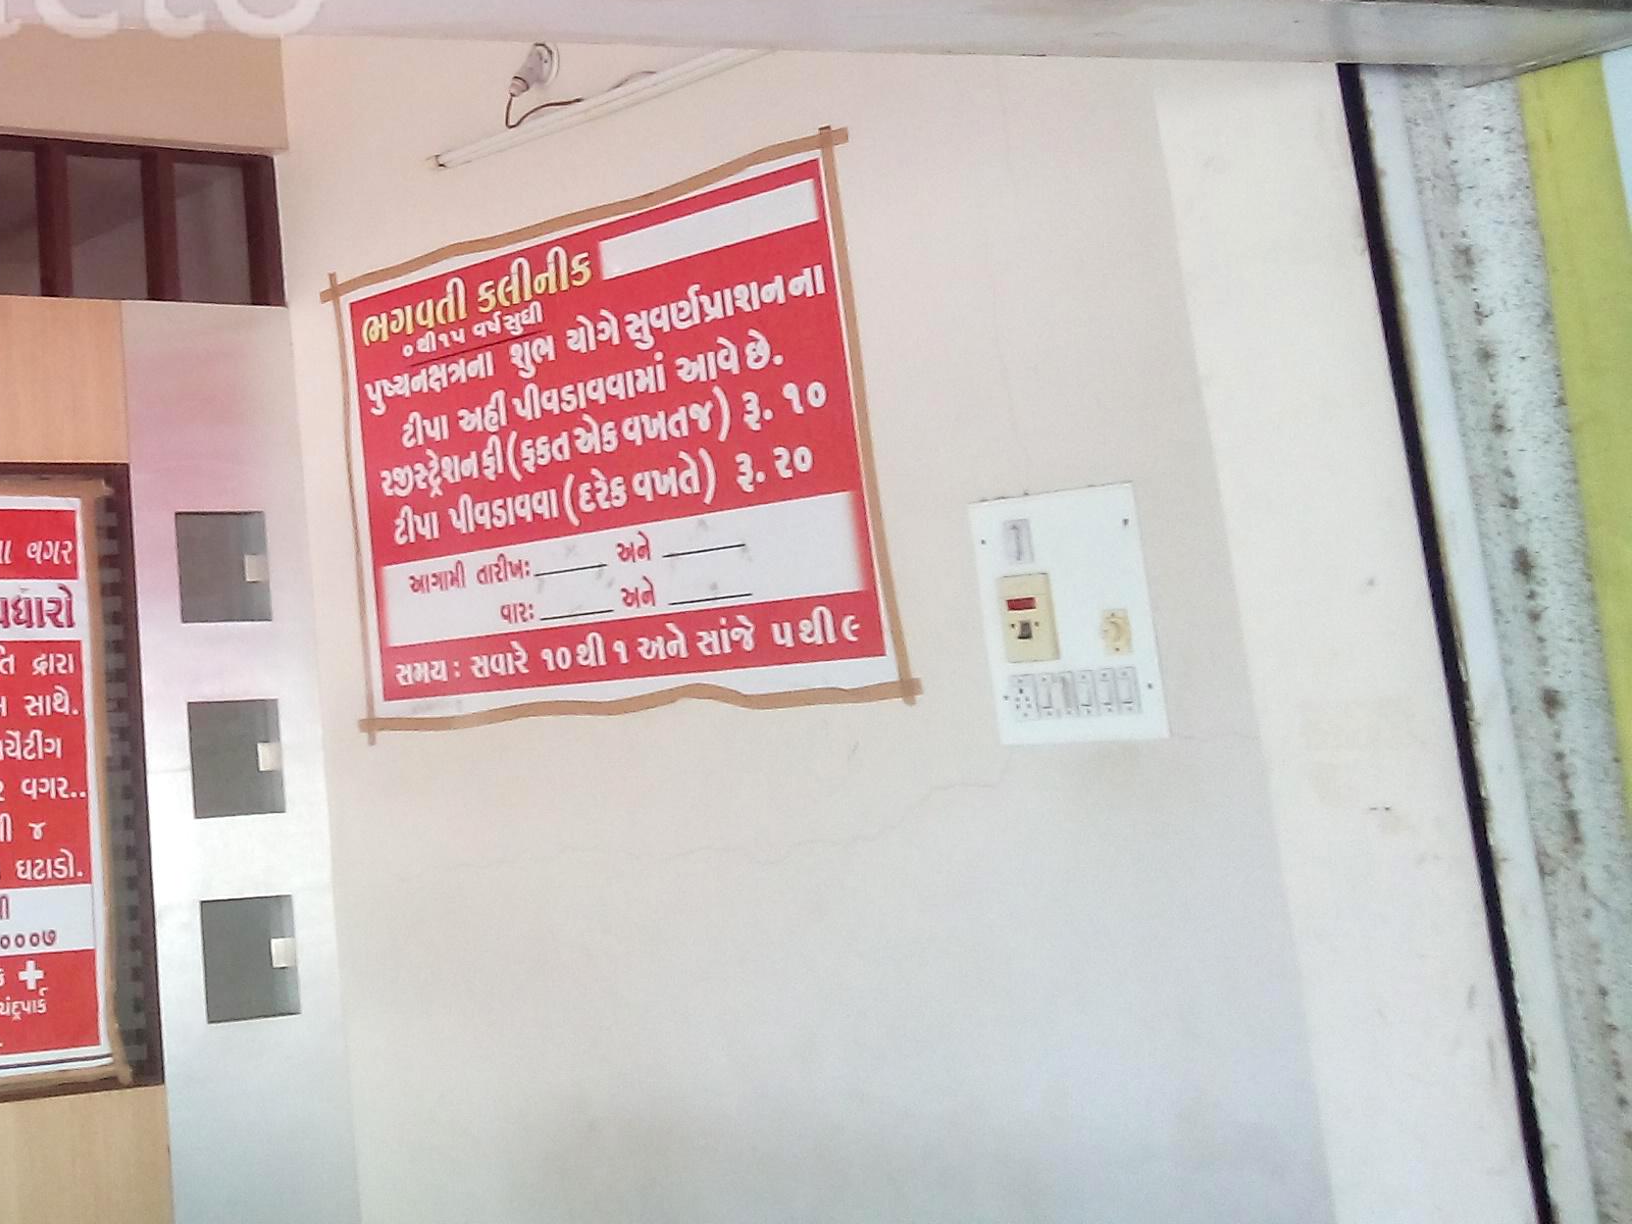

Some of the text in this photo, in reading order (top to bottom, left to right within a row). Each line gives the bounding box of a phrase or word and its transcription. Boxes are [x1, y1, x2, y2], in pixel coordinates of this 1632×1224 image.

[362, 245, 593, 347] ભગવતી કલીનીક
[510, 335, 557, 380] શુભ
[566, 309, 620, 353] યોગે
[402, 411, 450, 448] ટીપા
[512, 351, 667, 422] પીવડાવવામાં
[675, 336, 740, 383] આવે
[744, 328, 784, 370] છે.
[782, 381, 828, 415] ૧૦
[394, 505, 440, 545] ટીપા
[448, 493, 560, 534] પીવડાવવા
[772, 445, 814, 479] ૨૦
[26, 540, 74, 565] વગર
[409, 560, 467, 594] આગામી
[616, 530, 652, 564] અને
[620, 575, 656, 608] અને
[470, 640, 530, 679] સવારે
[637, 622, 689, 662] અને
[696, 614, 756, 656] સાંજે
[23, 685, 80, 717] સાથે.
[28, 821, 47, 841] ૪
